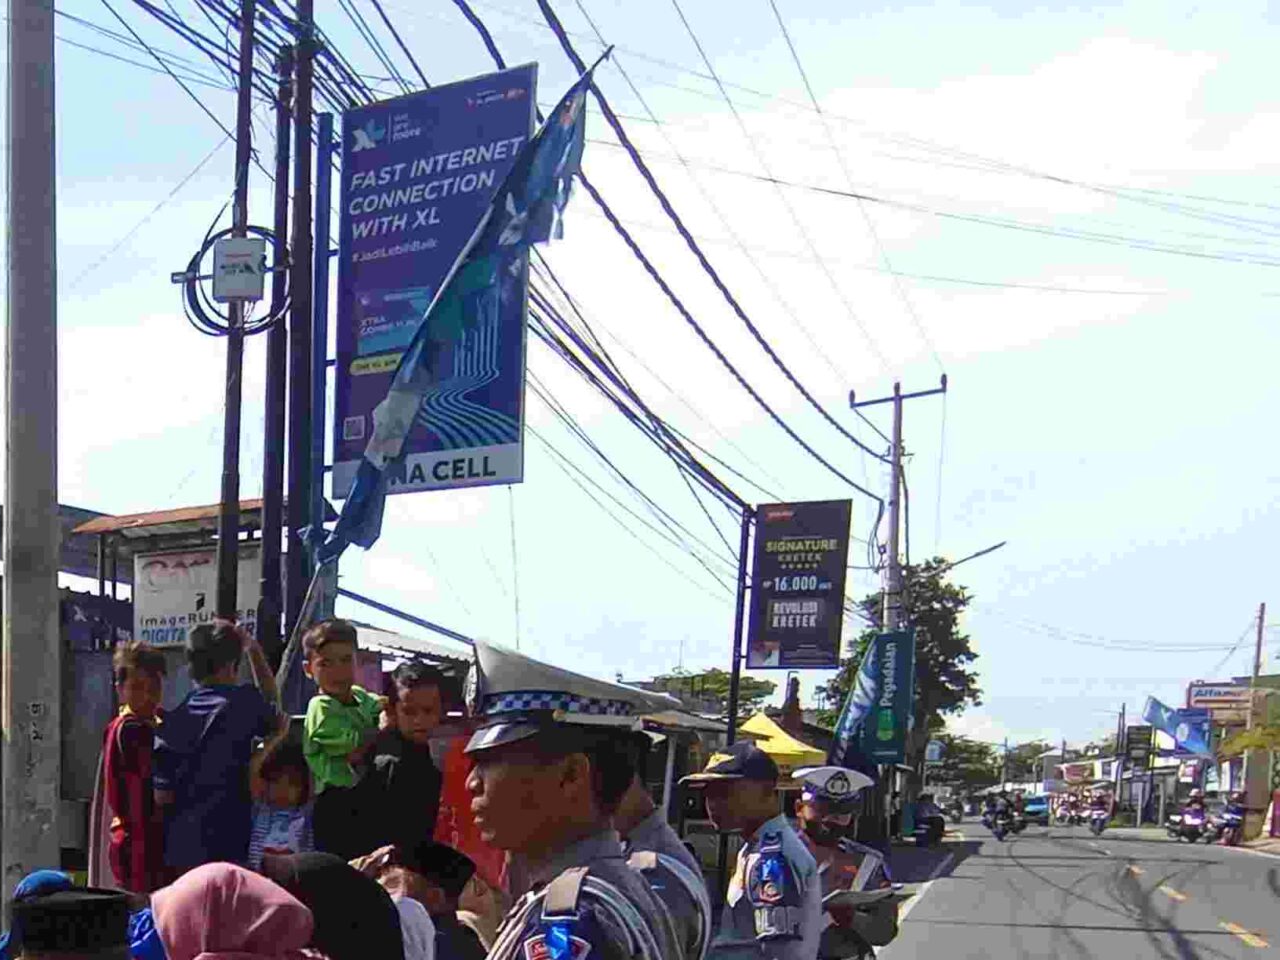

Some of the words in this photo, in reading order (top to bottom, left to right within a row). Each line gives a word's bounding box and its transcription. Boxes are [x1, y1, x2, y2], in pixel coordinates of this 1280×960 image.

[350, 163, 407, 191] FAST
[410, 136, 525, 179] INTERNET
[349, 169, 496, 216] CONNECTION
[352, 213, 408, 241] WITH
[412, 206, 440, 231] XL
[432, 456, 496, 481] CELL
[765, 539, 838, 553] SIGNATURE
[774, 575, 817, 592] 16.000
